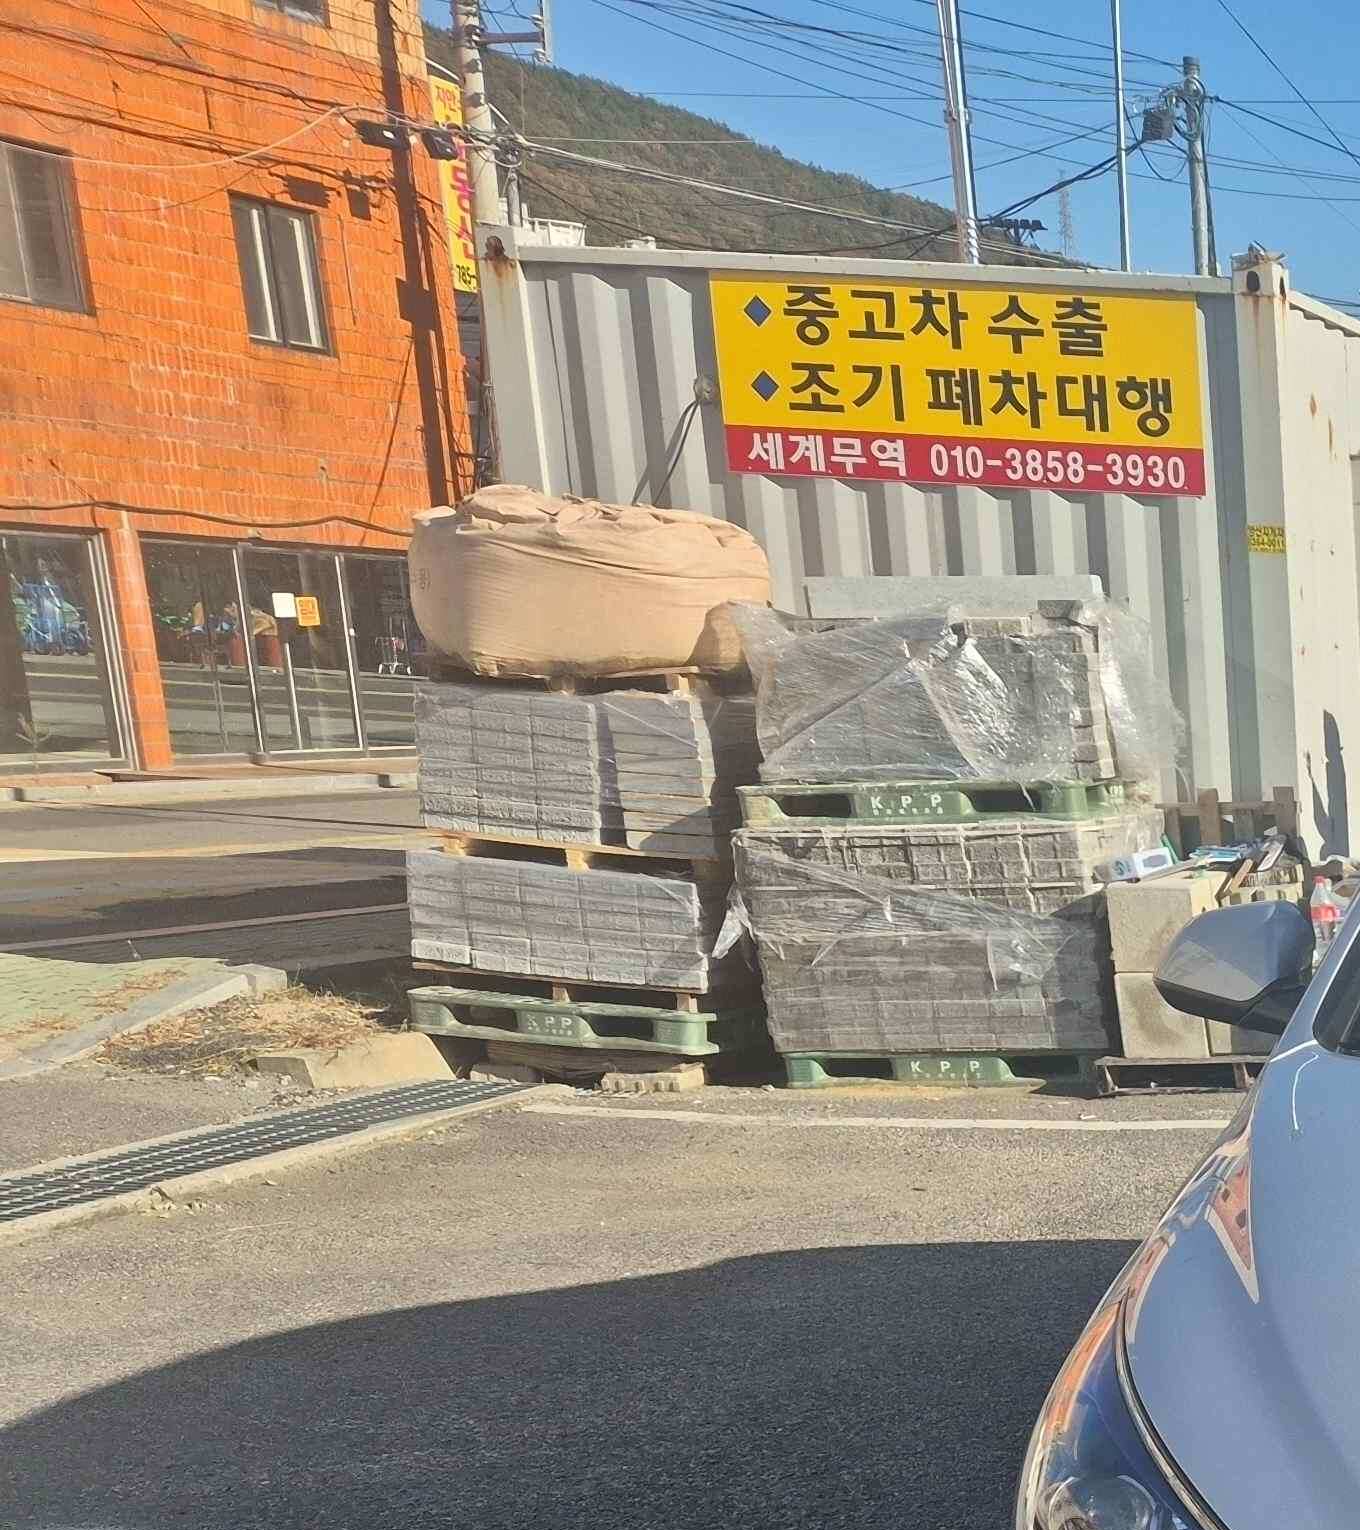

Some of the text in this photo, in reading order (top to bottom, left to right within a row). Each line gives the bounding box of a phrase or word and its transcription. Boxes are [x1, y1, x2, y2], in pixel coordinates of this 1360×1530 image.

[783, 286, 1108, 357] 중고차 수출
[789, 362, 1173, 437] 조기 폐차대행
[748, 432, 1186, 489] 세계무역 010-3858-3930
